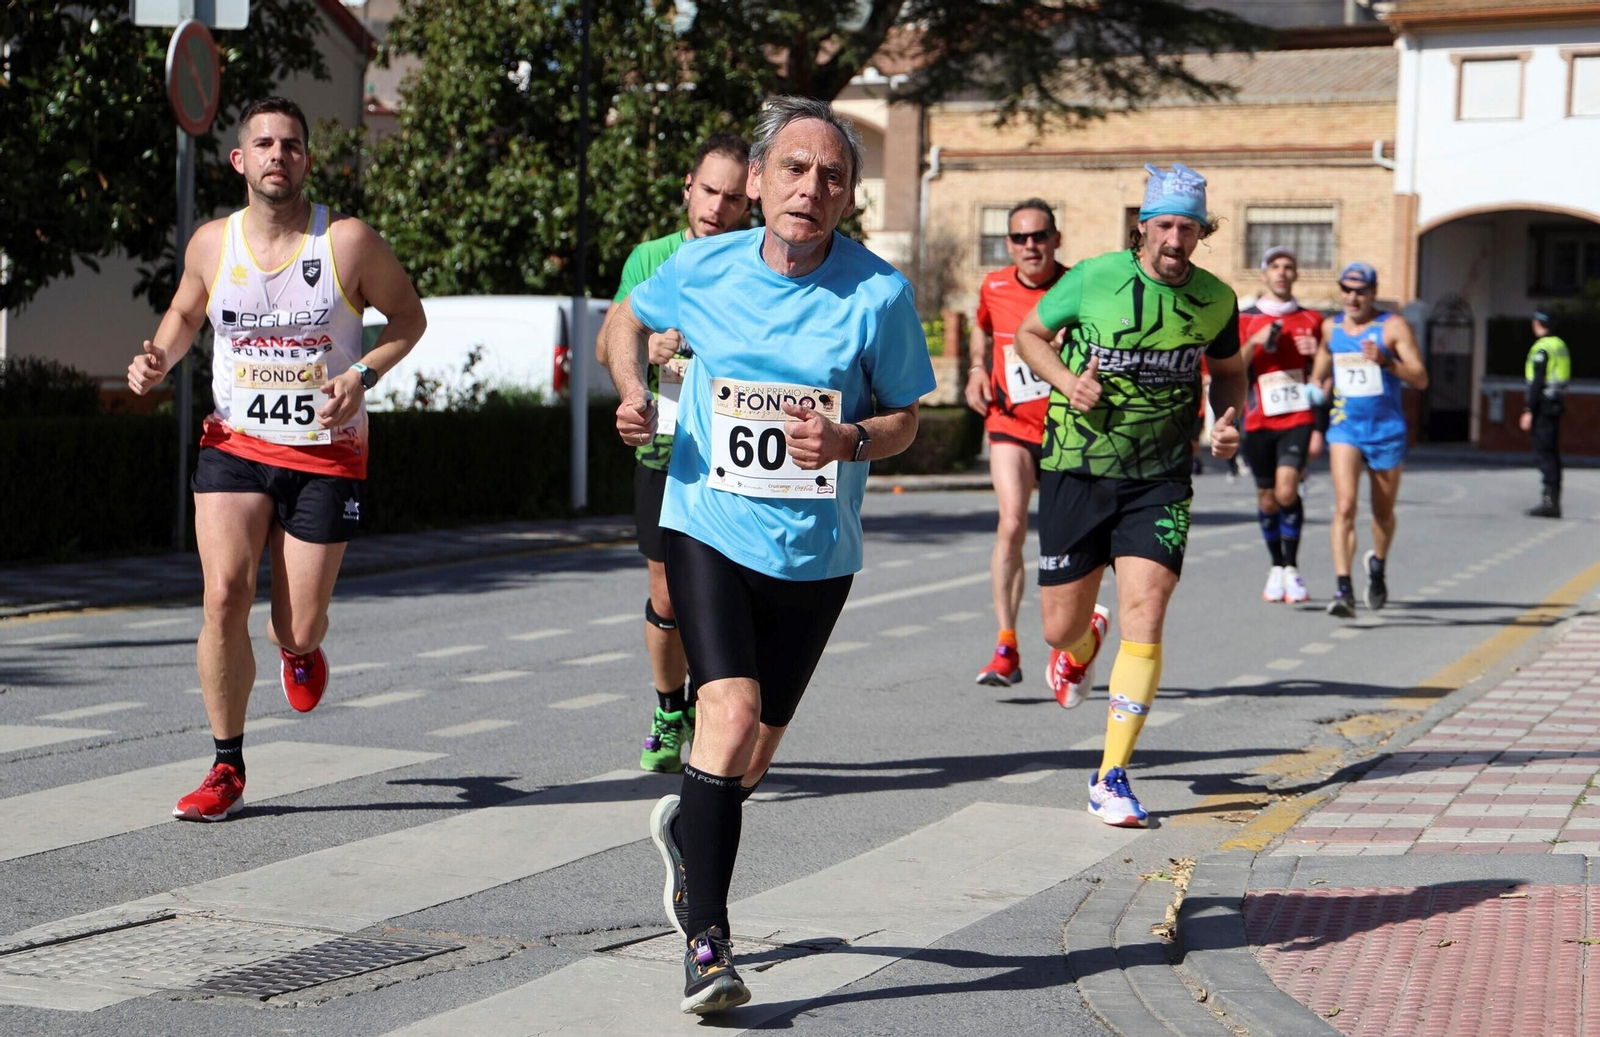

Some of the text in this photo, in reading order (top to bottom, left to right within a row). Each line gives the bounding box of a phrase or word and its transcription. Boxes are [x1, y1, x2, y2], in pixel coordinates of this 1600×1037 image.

[232, 343, 333, 358] RUNNERS
[252, 369, 310, 382] FONDO
[1346, 369, 1367, 384] 73
[739, 385, 764, 395] GRAN
[766, 387, 802, 397] PREMIO
[1270, 386, 1300, 403] 675
[737, 391, 816, 411] FONDO
[247, 394, 315, 426] 445
[729, 425, 787, 471] 60
